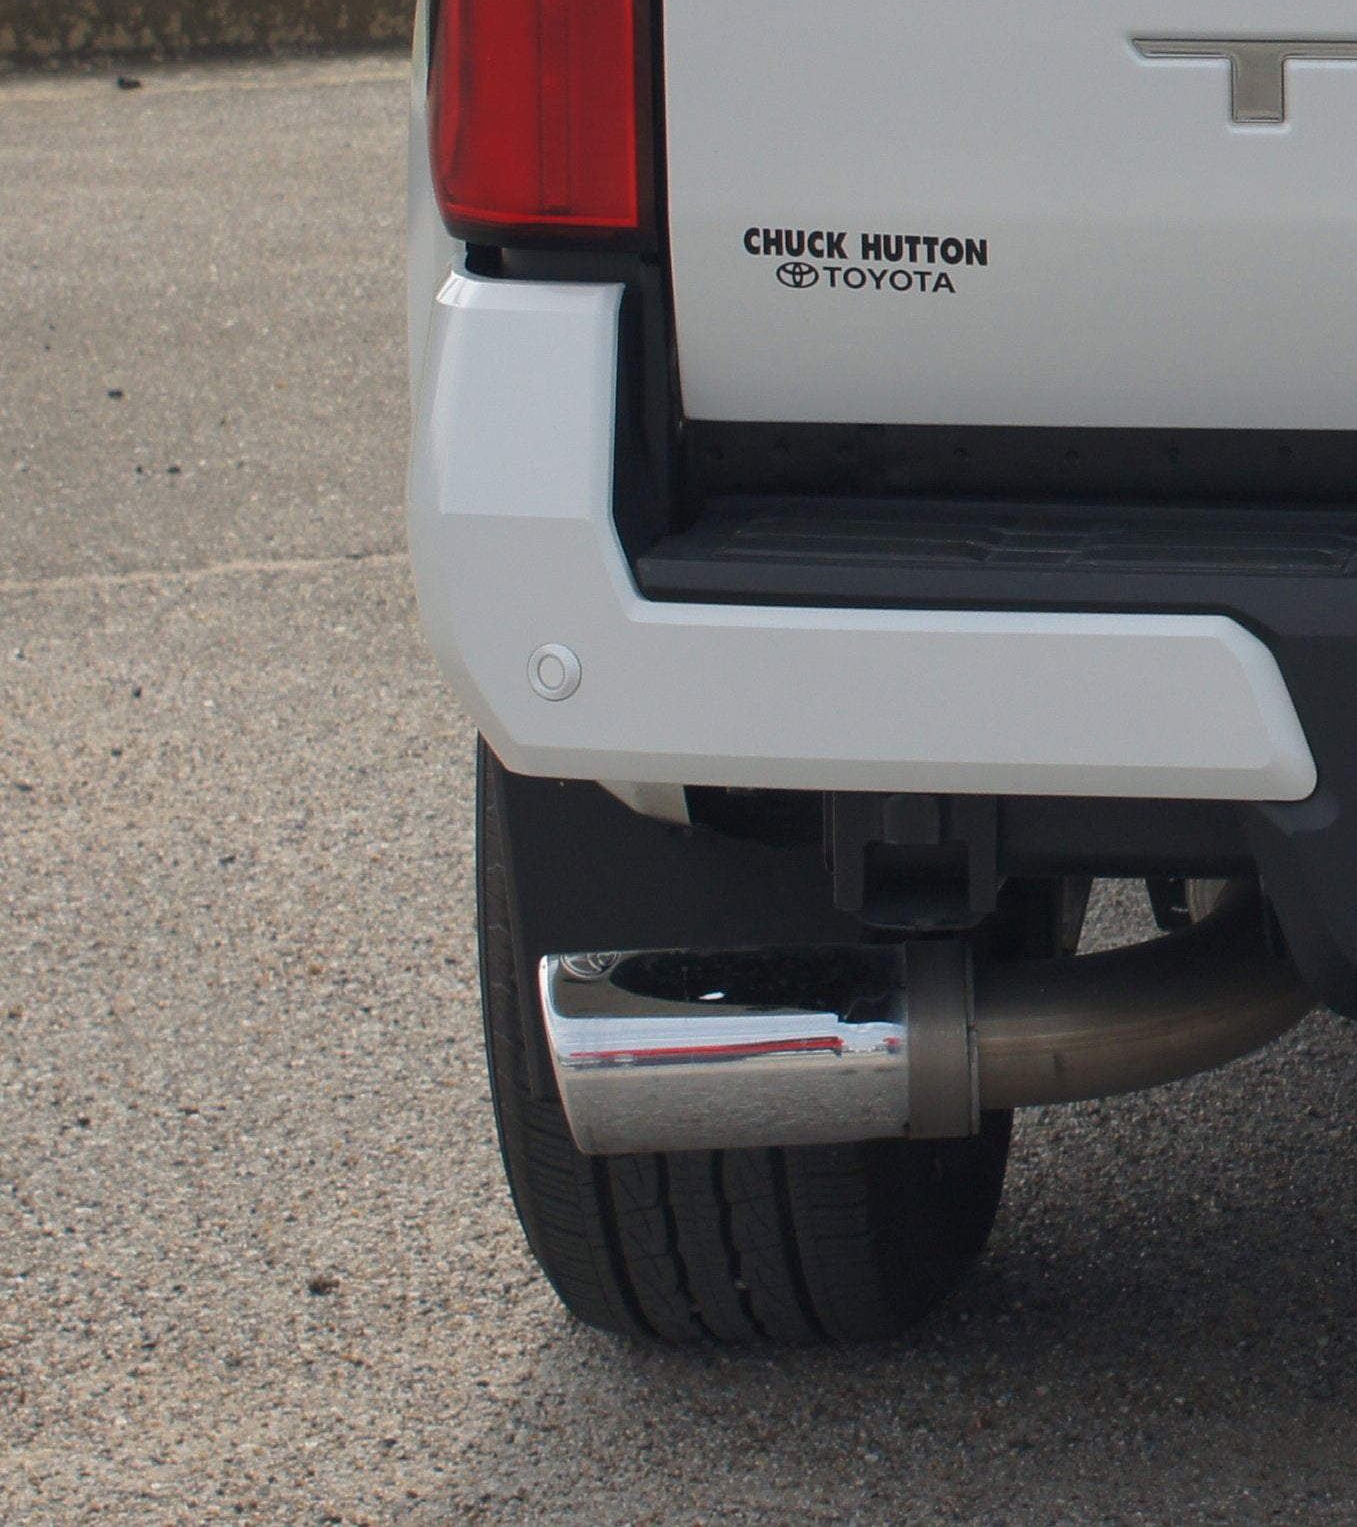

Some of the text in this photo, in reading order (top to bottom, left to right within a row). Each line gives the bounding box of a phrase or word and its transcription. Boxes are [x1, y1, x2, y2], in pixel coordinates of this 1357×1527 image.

[743, 227, 988, 266] CHUCK HUTTON
[822, 266, 956, 294] TOYOTA
